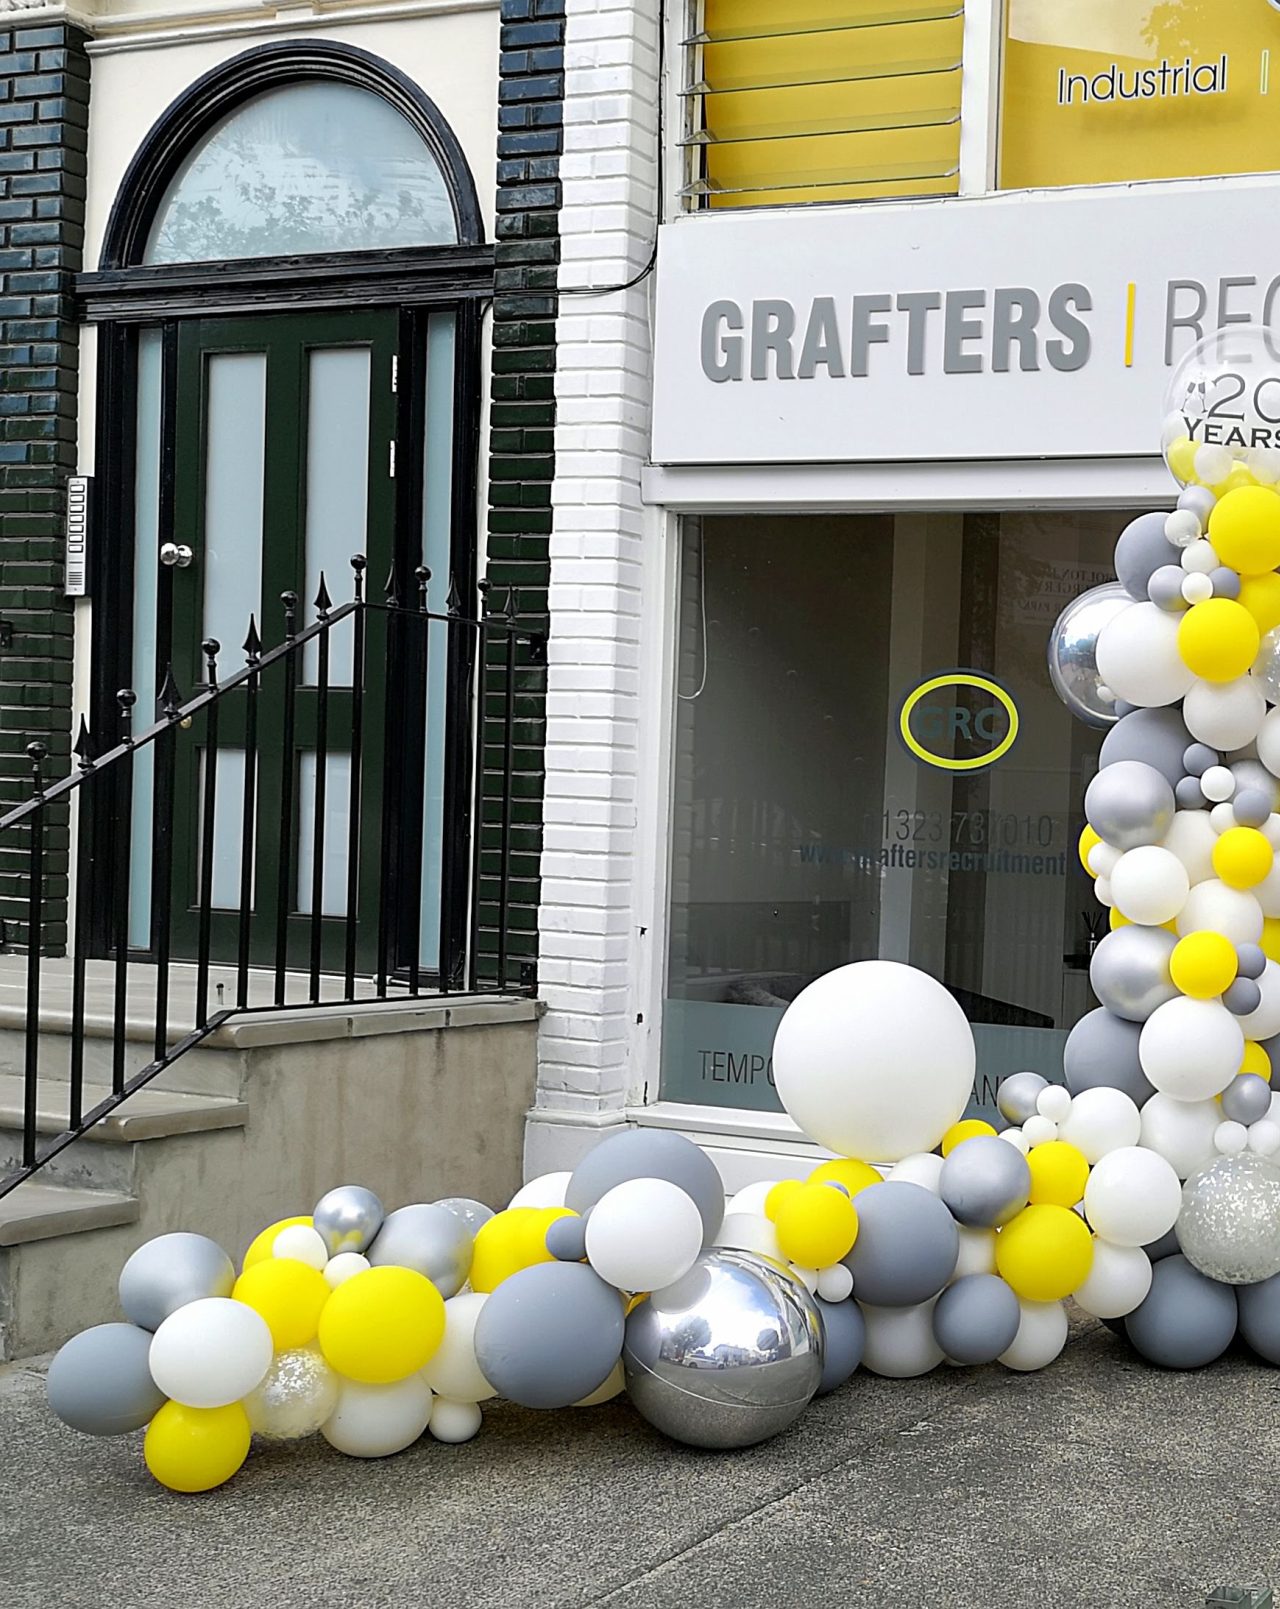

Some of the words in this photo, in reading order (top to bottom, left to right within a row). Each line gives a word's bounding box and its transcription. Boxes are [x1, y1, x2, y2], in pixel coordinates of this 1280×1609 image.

[1057, 53, 1228, 104] Industrial
[699, 282, 1093, 383] GRAFTERS
[916, 706, 1004, 742] GRC
